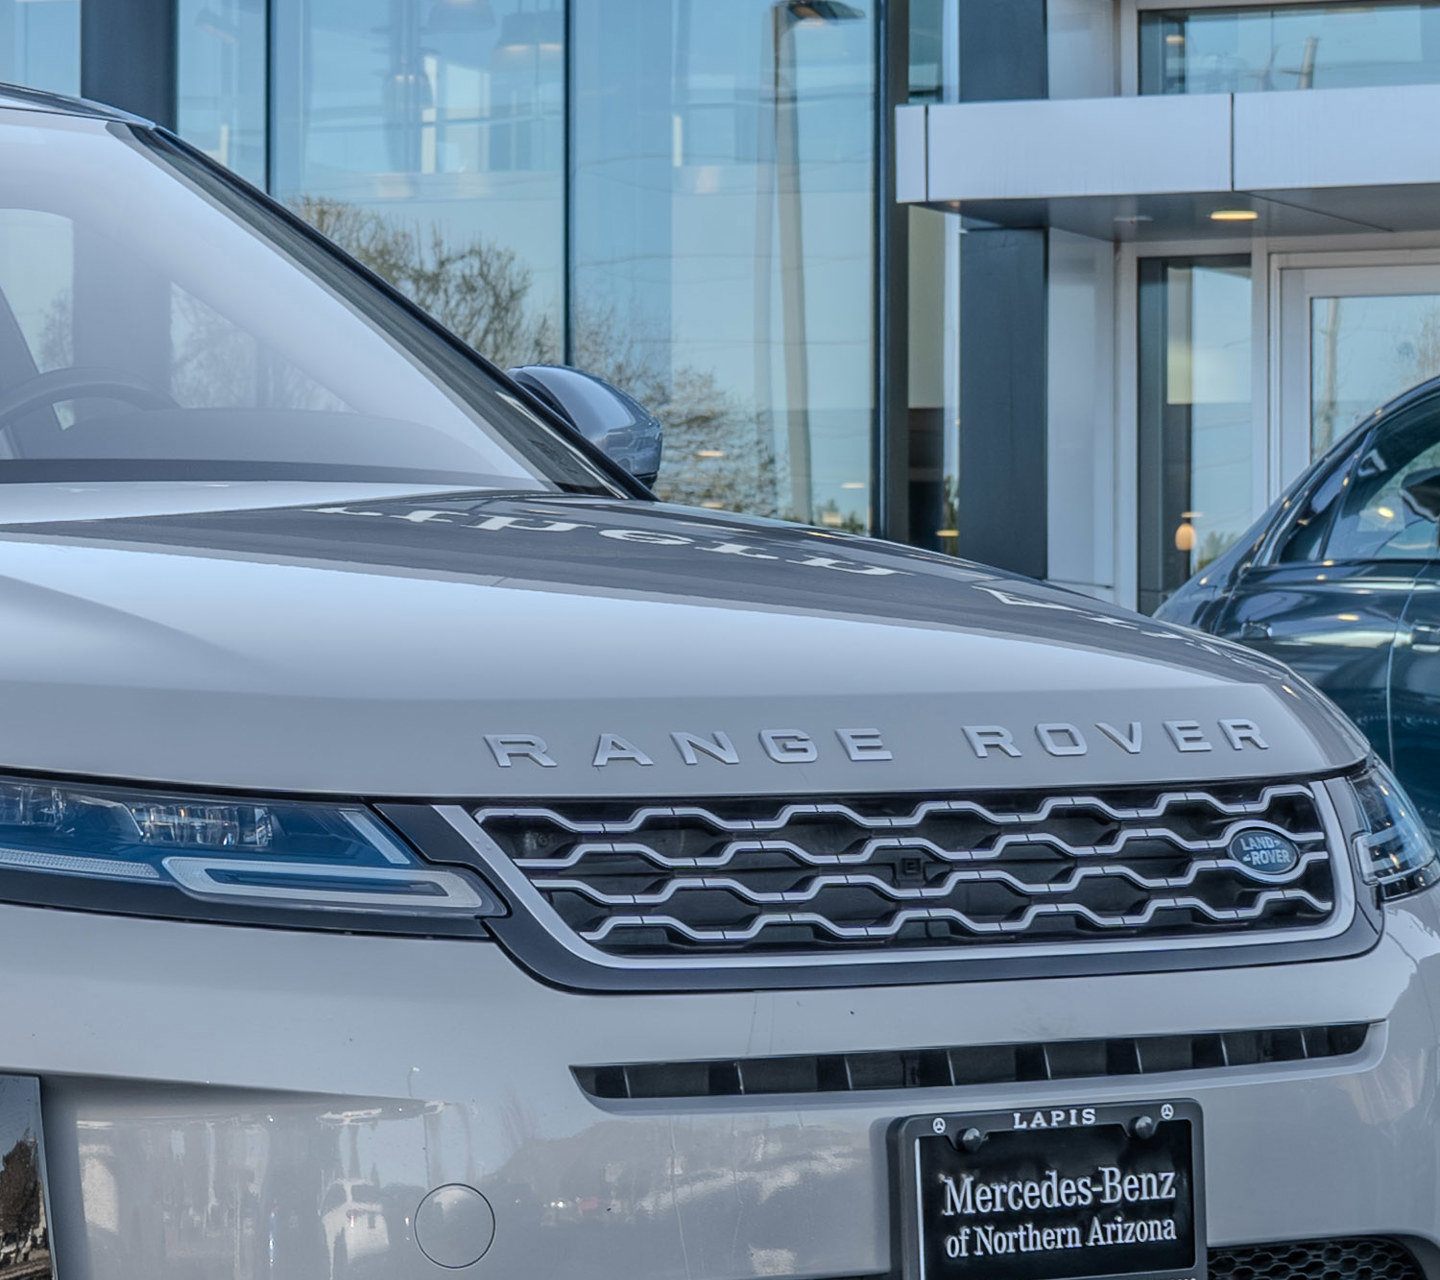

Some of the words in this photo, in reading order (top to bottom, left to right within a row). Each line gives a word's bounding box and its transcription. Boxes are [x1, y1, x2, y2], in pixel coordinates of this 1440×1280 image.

[484, 726, 894, 768] RANGE
[961, 718, 1271, 760] ROVER
[1240, 835, 1276, 851] LAND
[1250, 849, 1292, 866] ROVER
[1013, 1108, 1097, 1130] LAPIS
[941, 1165, 1177, 1217] Mercedes-Benz
[946, 1226, 969, 1259] of
[972, 1220, 1082, 1257] Northern
[1085, 1215, 1177, 1249] Arizona
